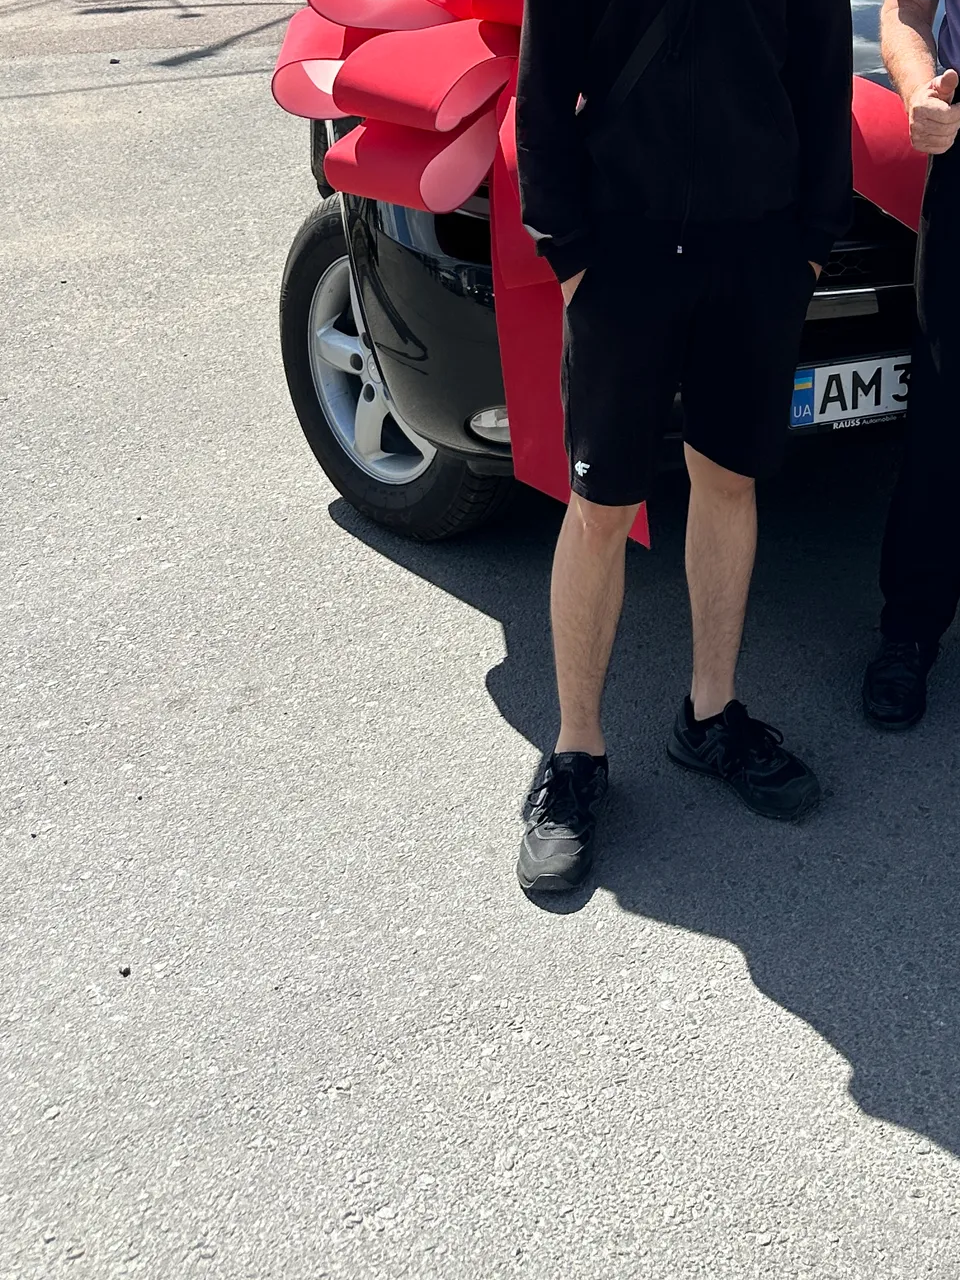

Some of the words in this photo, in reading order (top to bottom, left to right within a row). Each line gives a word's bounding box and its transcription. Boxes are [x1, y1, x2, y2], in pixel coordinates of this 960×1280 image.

[819, 367, 882, 415] AM
[793, 404, 812, 418] UA
[833, 419, 861, 430] RAUSS
